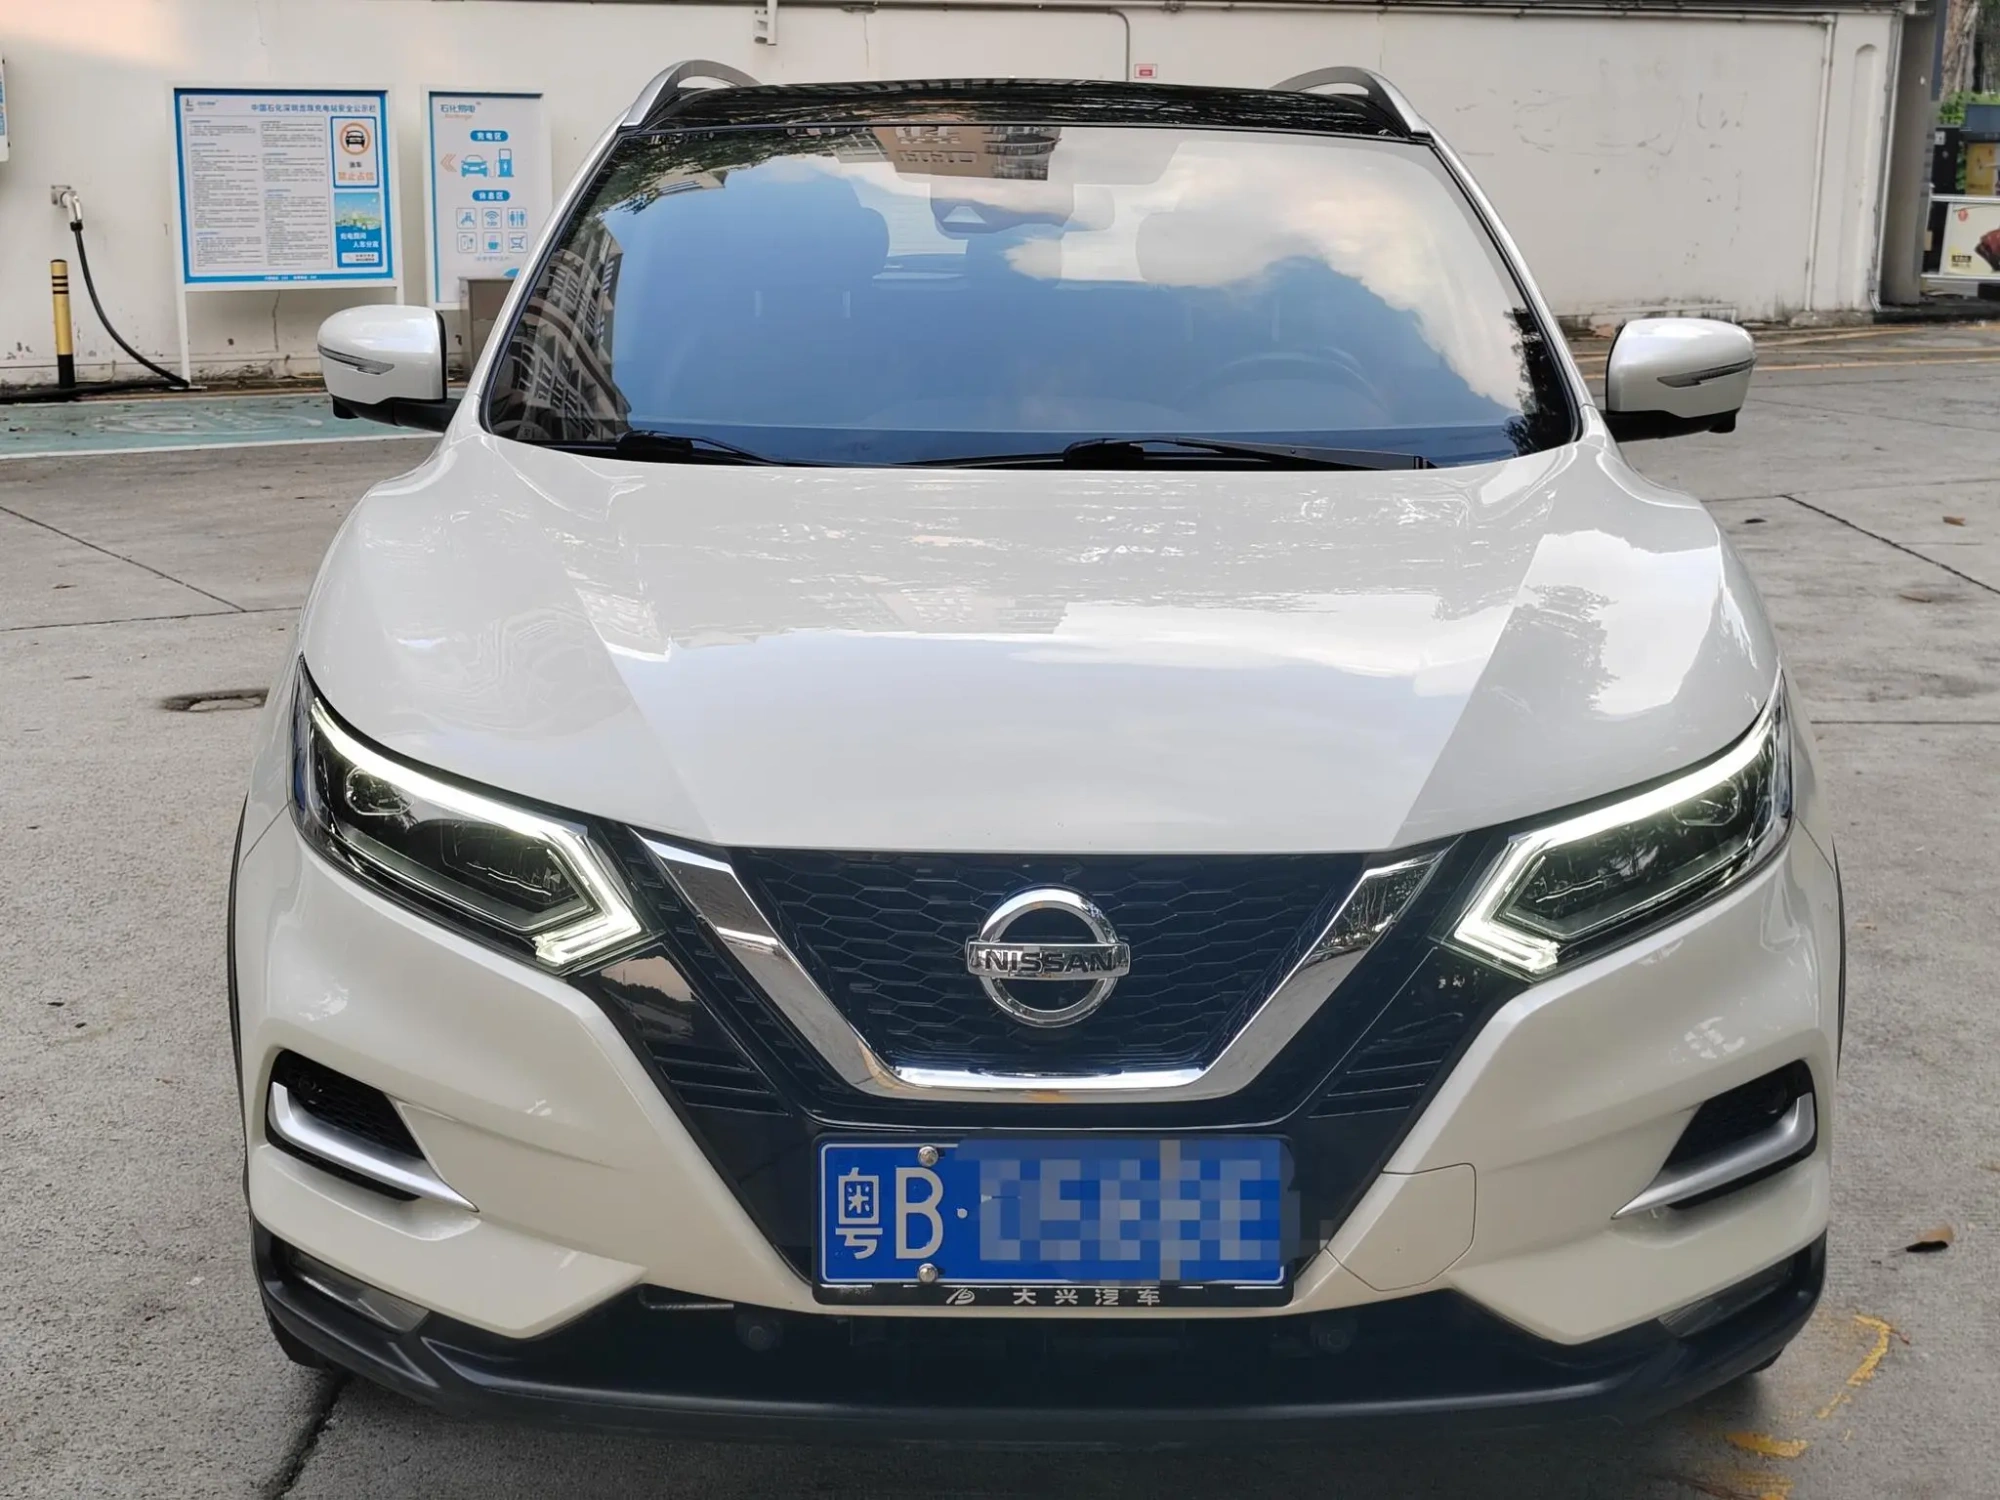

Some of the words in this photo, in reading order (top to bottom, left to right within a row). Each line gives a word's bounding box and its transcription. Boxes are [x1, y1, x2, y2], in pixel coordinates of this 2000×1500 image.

[985, 950, 1117, 973] NISSAN
[1013, 1288, 1160, 1306] 大兴汽车
